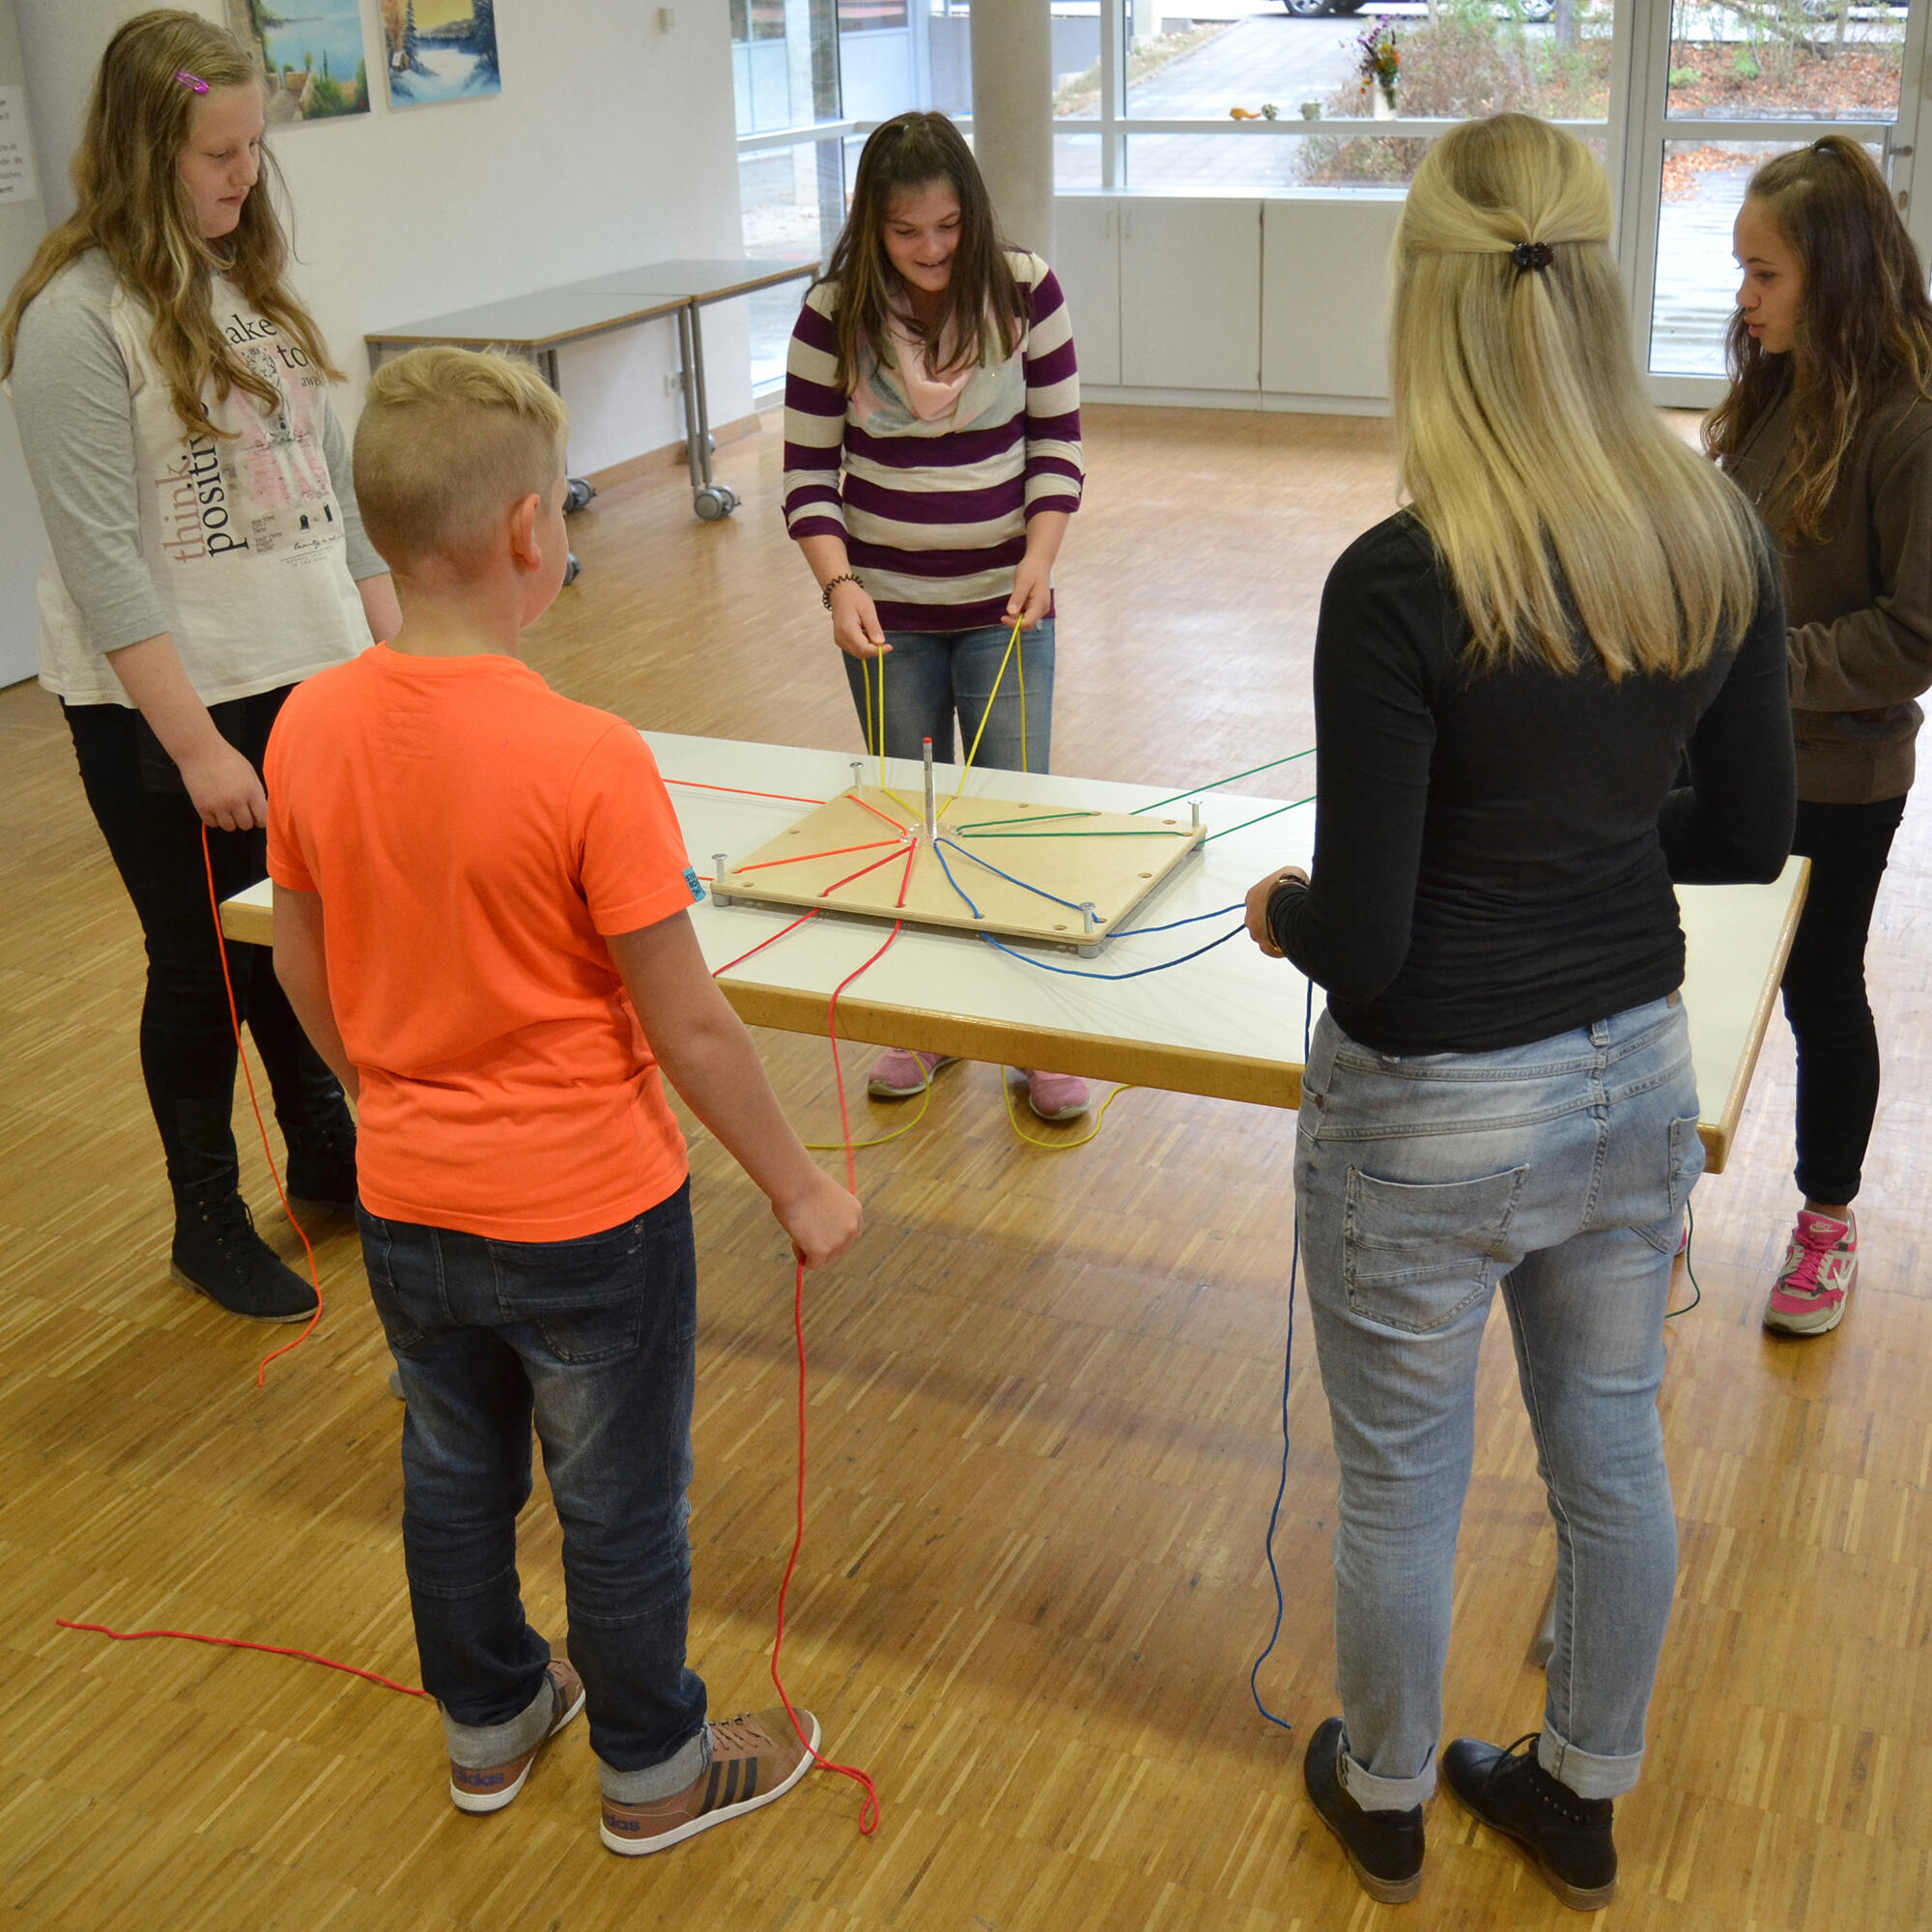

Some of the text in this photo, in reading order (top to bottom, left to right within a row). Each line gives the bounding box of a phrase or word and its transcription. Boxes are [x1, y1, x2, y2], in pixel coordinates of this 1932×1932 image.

[223, 313, 278, 346] ake
[276, 344, 309, 369] to
[182, 402, 249, 557] positi
[155, 464, 206, 563] think
